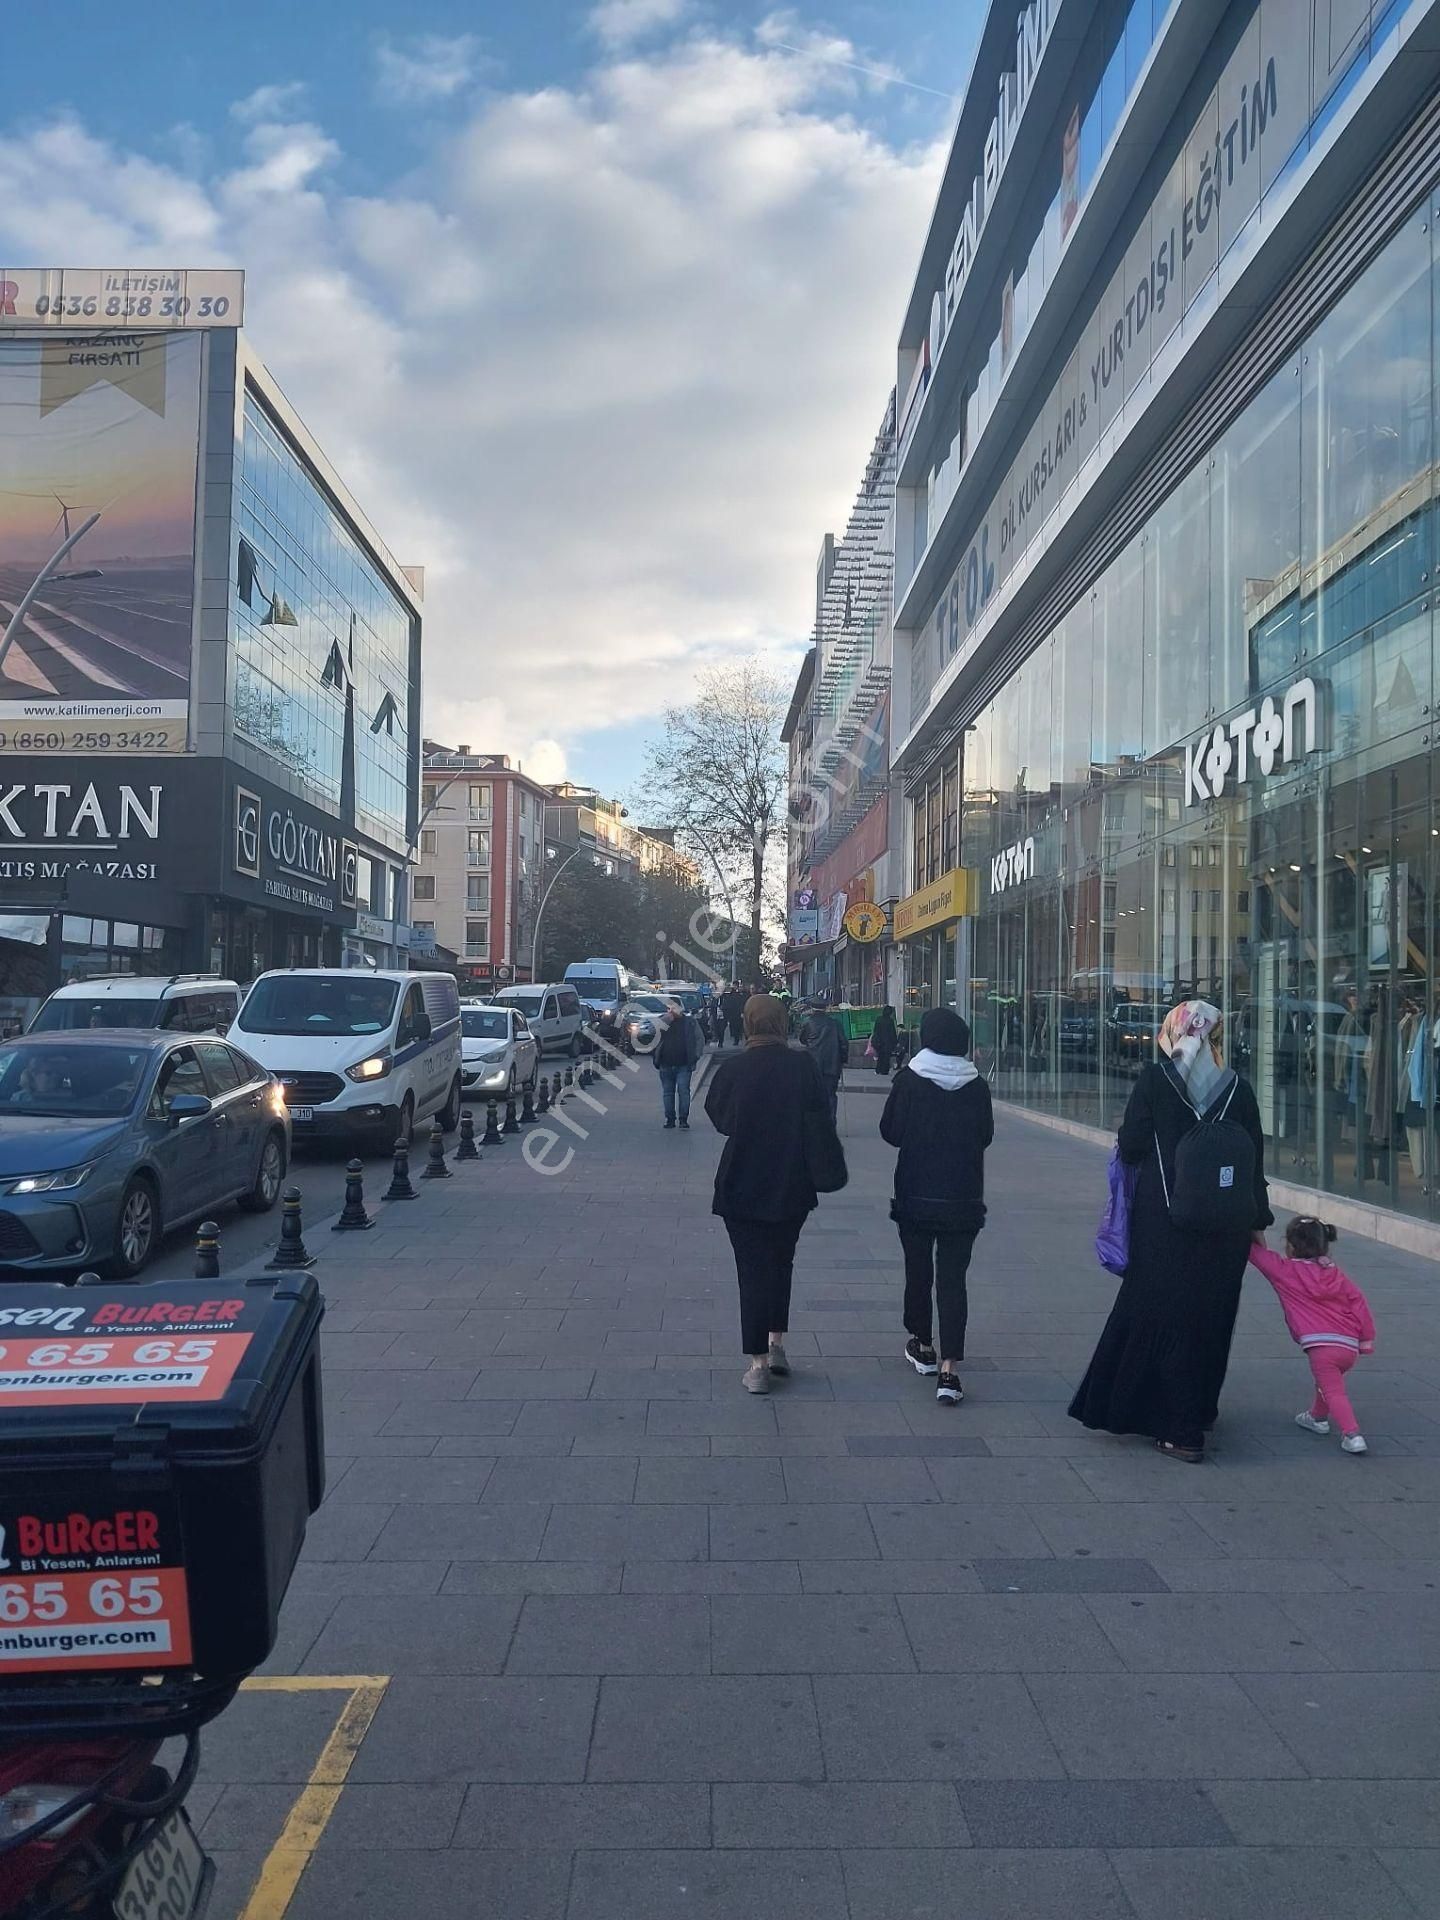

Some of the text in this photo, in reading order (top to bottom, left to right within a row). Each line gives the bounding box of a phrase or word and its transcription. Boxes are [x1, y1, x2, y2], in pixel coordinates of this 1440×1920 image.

[105, 274, 181, 295] İLETİŞİM
[1018, 398, 1076, 527] KURSLARI
[1079, 391, 1088, 428] &
[1091, 228, 1175, 403] YURTDIŞI
[1182, 56, 1278, 261] EĞİTİM
[36, 295, 230, 317] 0536 838 30 30
[68, 350, 141, 367] FIRSATI
[24, 704, 162, 717] www.katilimenerji.com
[13, 731, 65, 750] (850)
[72, 732, 111, 748] 259
[116, 732, 169, 748] 3422
[1184, 676, 1316, 808] KOTON
[268, 808, 338, 881] GÖKTAN
[990, 836, 1035, 895] KOTON
[162, 1321, 233, 1331] Anlarsın!
[27, 1343, 114, 1366] 65
[133, 1340, 218, 1364] 65
[21, 1554, 161, 1571] Bi Yesen, Anlarsın!
[0, 1577, 163, 1622] 65 65
